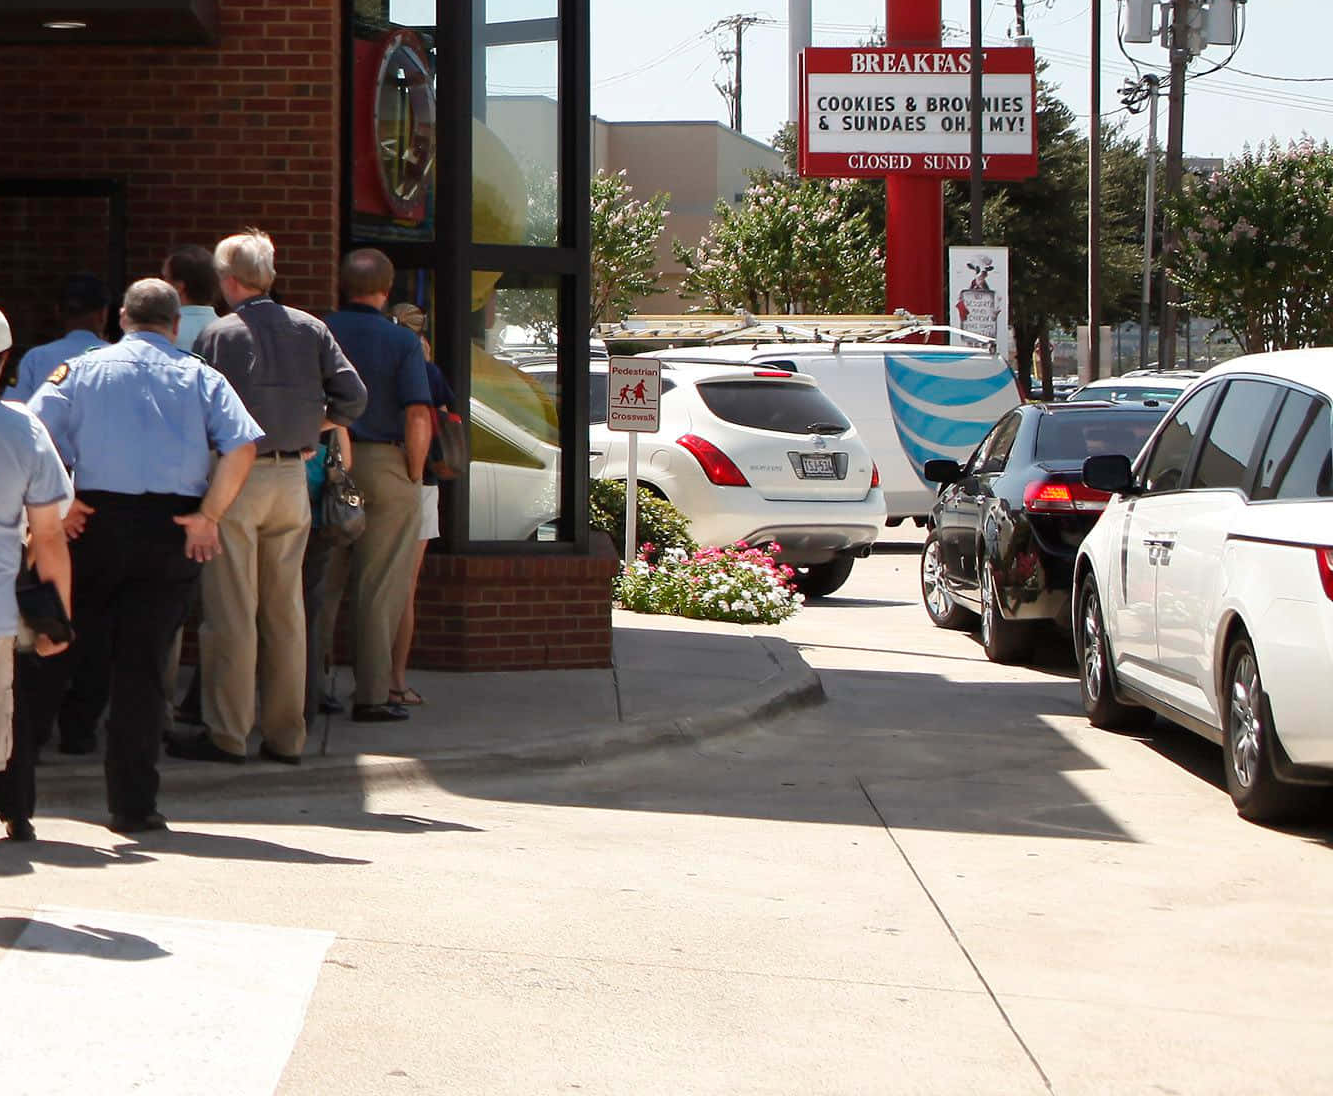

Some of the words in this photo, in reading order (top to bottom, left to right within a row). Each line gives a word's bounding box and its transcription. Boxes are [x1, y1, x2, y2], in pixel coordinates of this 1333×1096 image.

[851, 53, 988, 74] BREAKFAS
[817, 96, 895, 112] COOKIES
[905, 97, 917, 112] &
[818, 115, 830, 131] &
[842, 115, 926, 132] SUNDAES
[989, 116, 1025, 132] MY!
[848, 154, 912, 170] CLOSED
[924, 155, 991, 171] SUNDY
[612, 366, 658, 377] Pedestrian
[611, 411, 656, 422] Crosswalk
